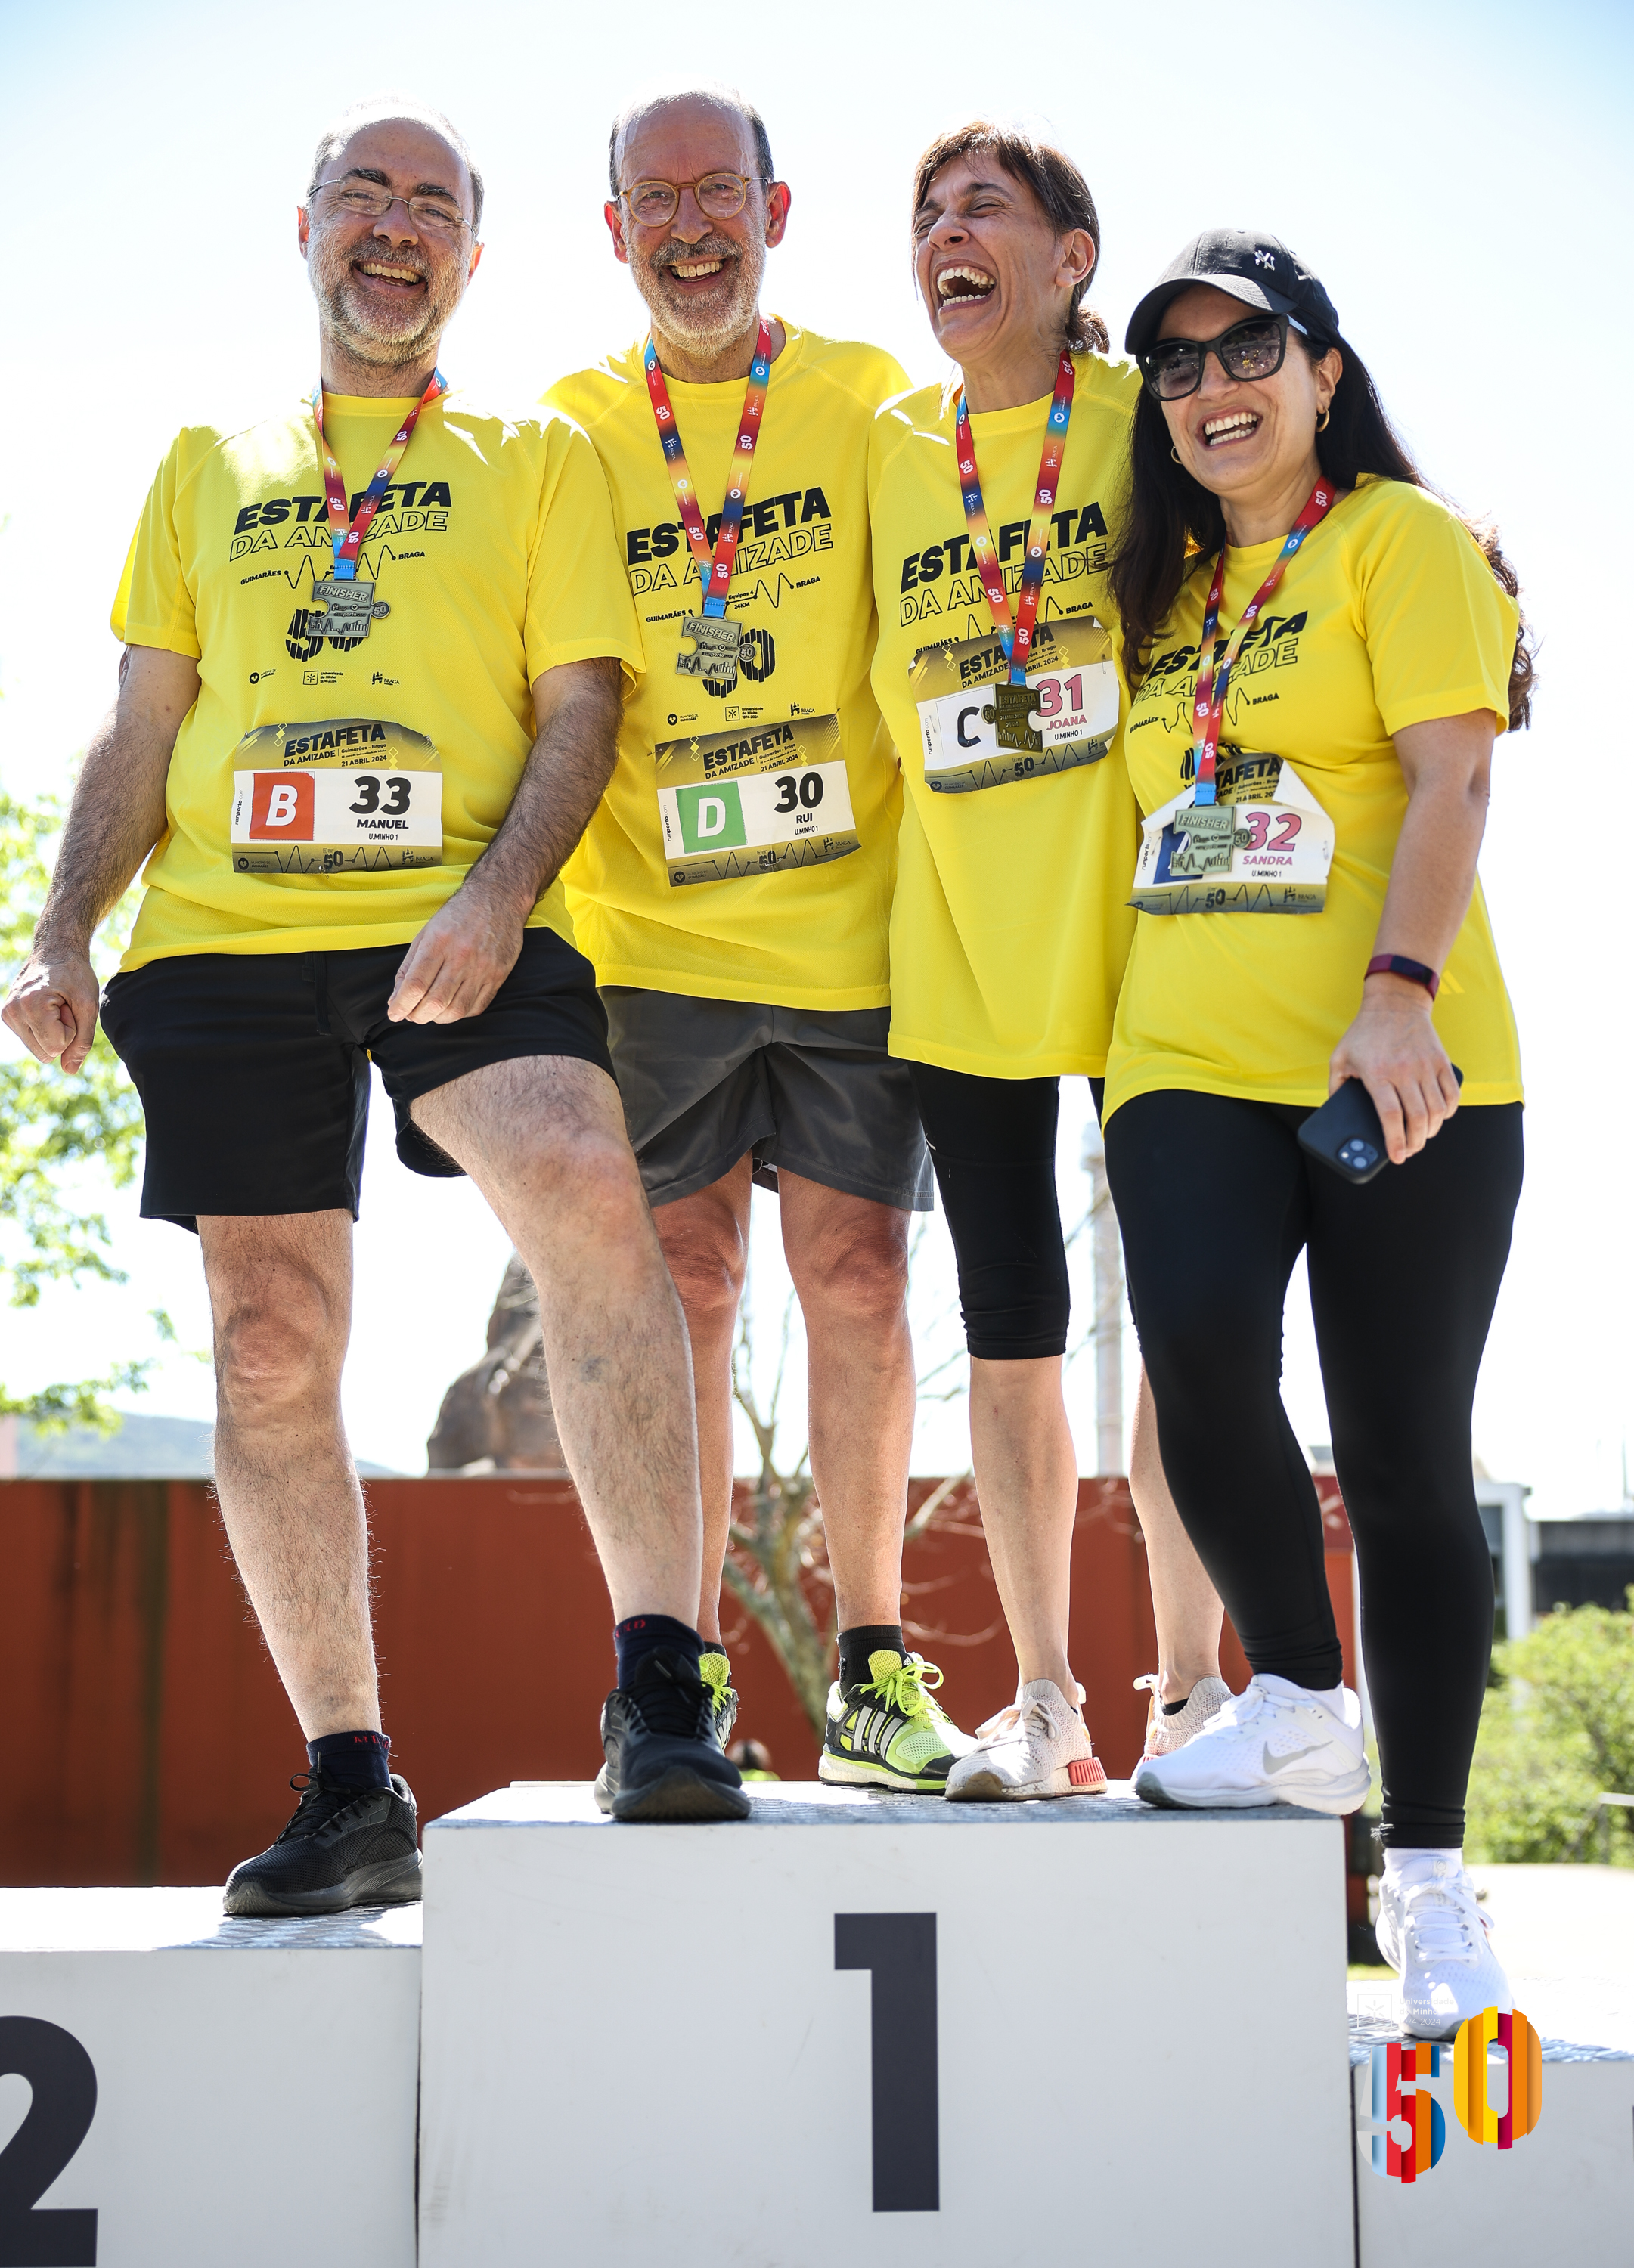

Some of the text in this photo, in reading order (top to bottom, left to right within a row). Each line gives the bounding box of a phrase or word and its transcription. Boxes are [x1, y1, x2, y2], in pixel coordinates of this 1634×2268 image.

[1063, 360, 1073, 376] 50
[656, 405, 670, 420] 50
[396, 430, 407, 441] 50
[740, 435, 752, 451] 50
[960, 459, 974, 474] 50
[329, 497, 345, 511] 50
[1039, 489, 1053, 505] 50
[1315, 491, 1327, 507] 50
[348, 531, 360, 544] 50
[688, 526, 704, 541] 50
[230, 530, 278, 562] DA
[398, 551, 426, 560] BRAGA
[240, 570, 281, 585] GUIMARÃES
[716, 562, 729, 579] 50
[631, 562, 677, 597] DA
[796, 576, 821, 588] BRAGA
[319, 586, 367, 601] FINISHER
[987, 587, 1003, 603] 50
[1210, 587, 1219, 601] 50
[374, 604, 387, 616] 50
[901, 588, 942, 627] DA
[1065, 602, 1093, 614] BRAGA
[1245, 605, 1258, 618] 50
[646, 609, 686, 623] GUIMARÃES
[689, 623, 735, 641] FINISHER
[1018, 627, 1030, 646] 50
[740, 648, 753, 658] 50
[1043, 655, 1059, 666] 2024
[961, 664, 1008, 689] DA AMIZADE
[1000, 692, 1036, 705] ESTAFETA
[1035, 674, 1083, 717] 31
[1252, 692, 1279, 705] BRAGA
[1196, 702, 1209, 717] 50
[957, 706, 981, 748] C
[1046, 714, 1087, 731] JOANA
[284, 723, 386, 758] ESTAFETA
[1054, 731, 1079, 740] U.MINHO
[702, 723, 794, 771] ESTAFETA
[759, 749, 781, 760] Guimarães
[1205, 742, 1214, 759] 50
[284, 751, 336, 767] DA AMIZADE
[349, 758, 370, 766] ABRIL
[768, 759, 786, 770] ABRIL
[786, 754, 798, 763] 2024
[1014, 757, 1034, 777] 50
[705, 758, 755, 780] DA AMIZADE
[1215, 757, 1282, 792] TAFETA
[349, 776, 411, 816] 33
[774, 771, 824, 813] 30
[1242, 793, 1263, 801] ABRIL
[265, 785, 299, 826] B
[356, 819, 409, 829] MANUEL
[697, 797, 726, 838] D
[796, 813, 813, 824] RUI
[1181, 816, 1228, 829] FINISHER
[795, 826, 814, 836] U.MINHO
[1236, 832, 1248, 844] 50
[1245, 812, 1302, 851] 32
[324, 850, 344, 869] 50
[758, 850, 777, 870] 50
[1242, 855, 1293, 866] SANDRA
[1205, 888, 1226, 908] 50
[833, 1912, 940, 2212] 1
[0, 2015, 98, 2267] 2
